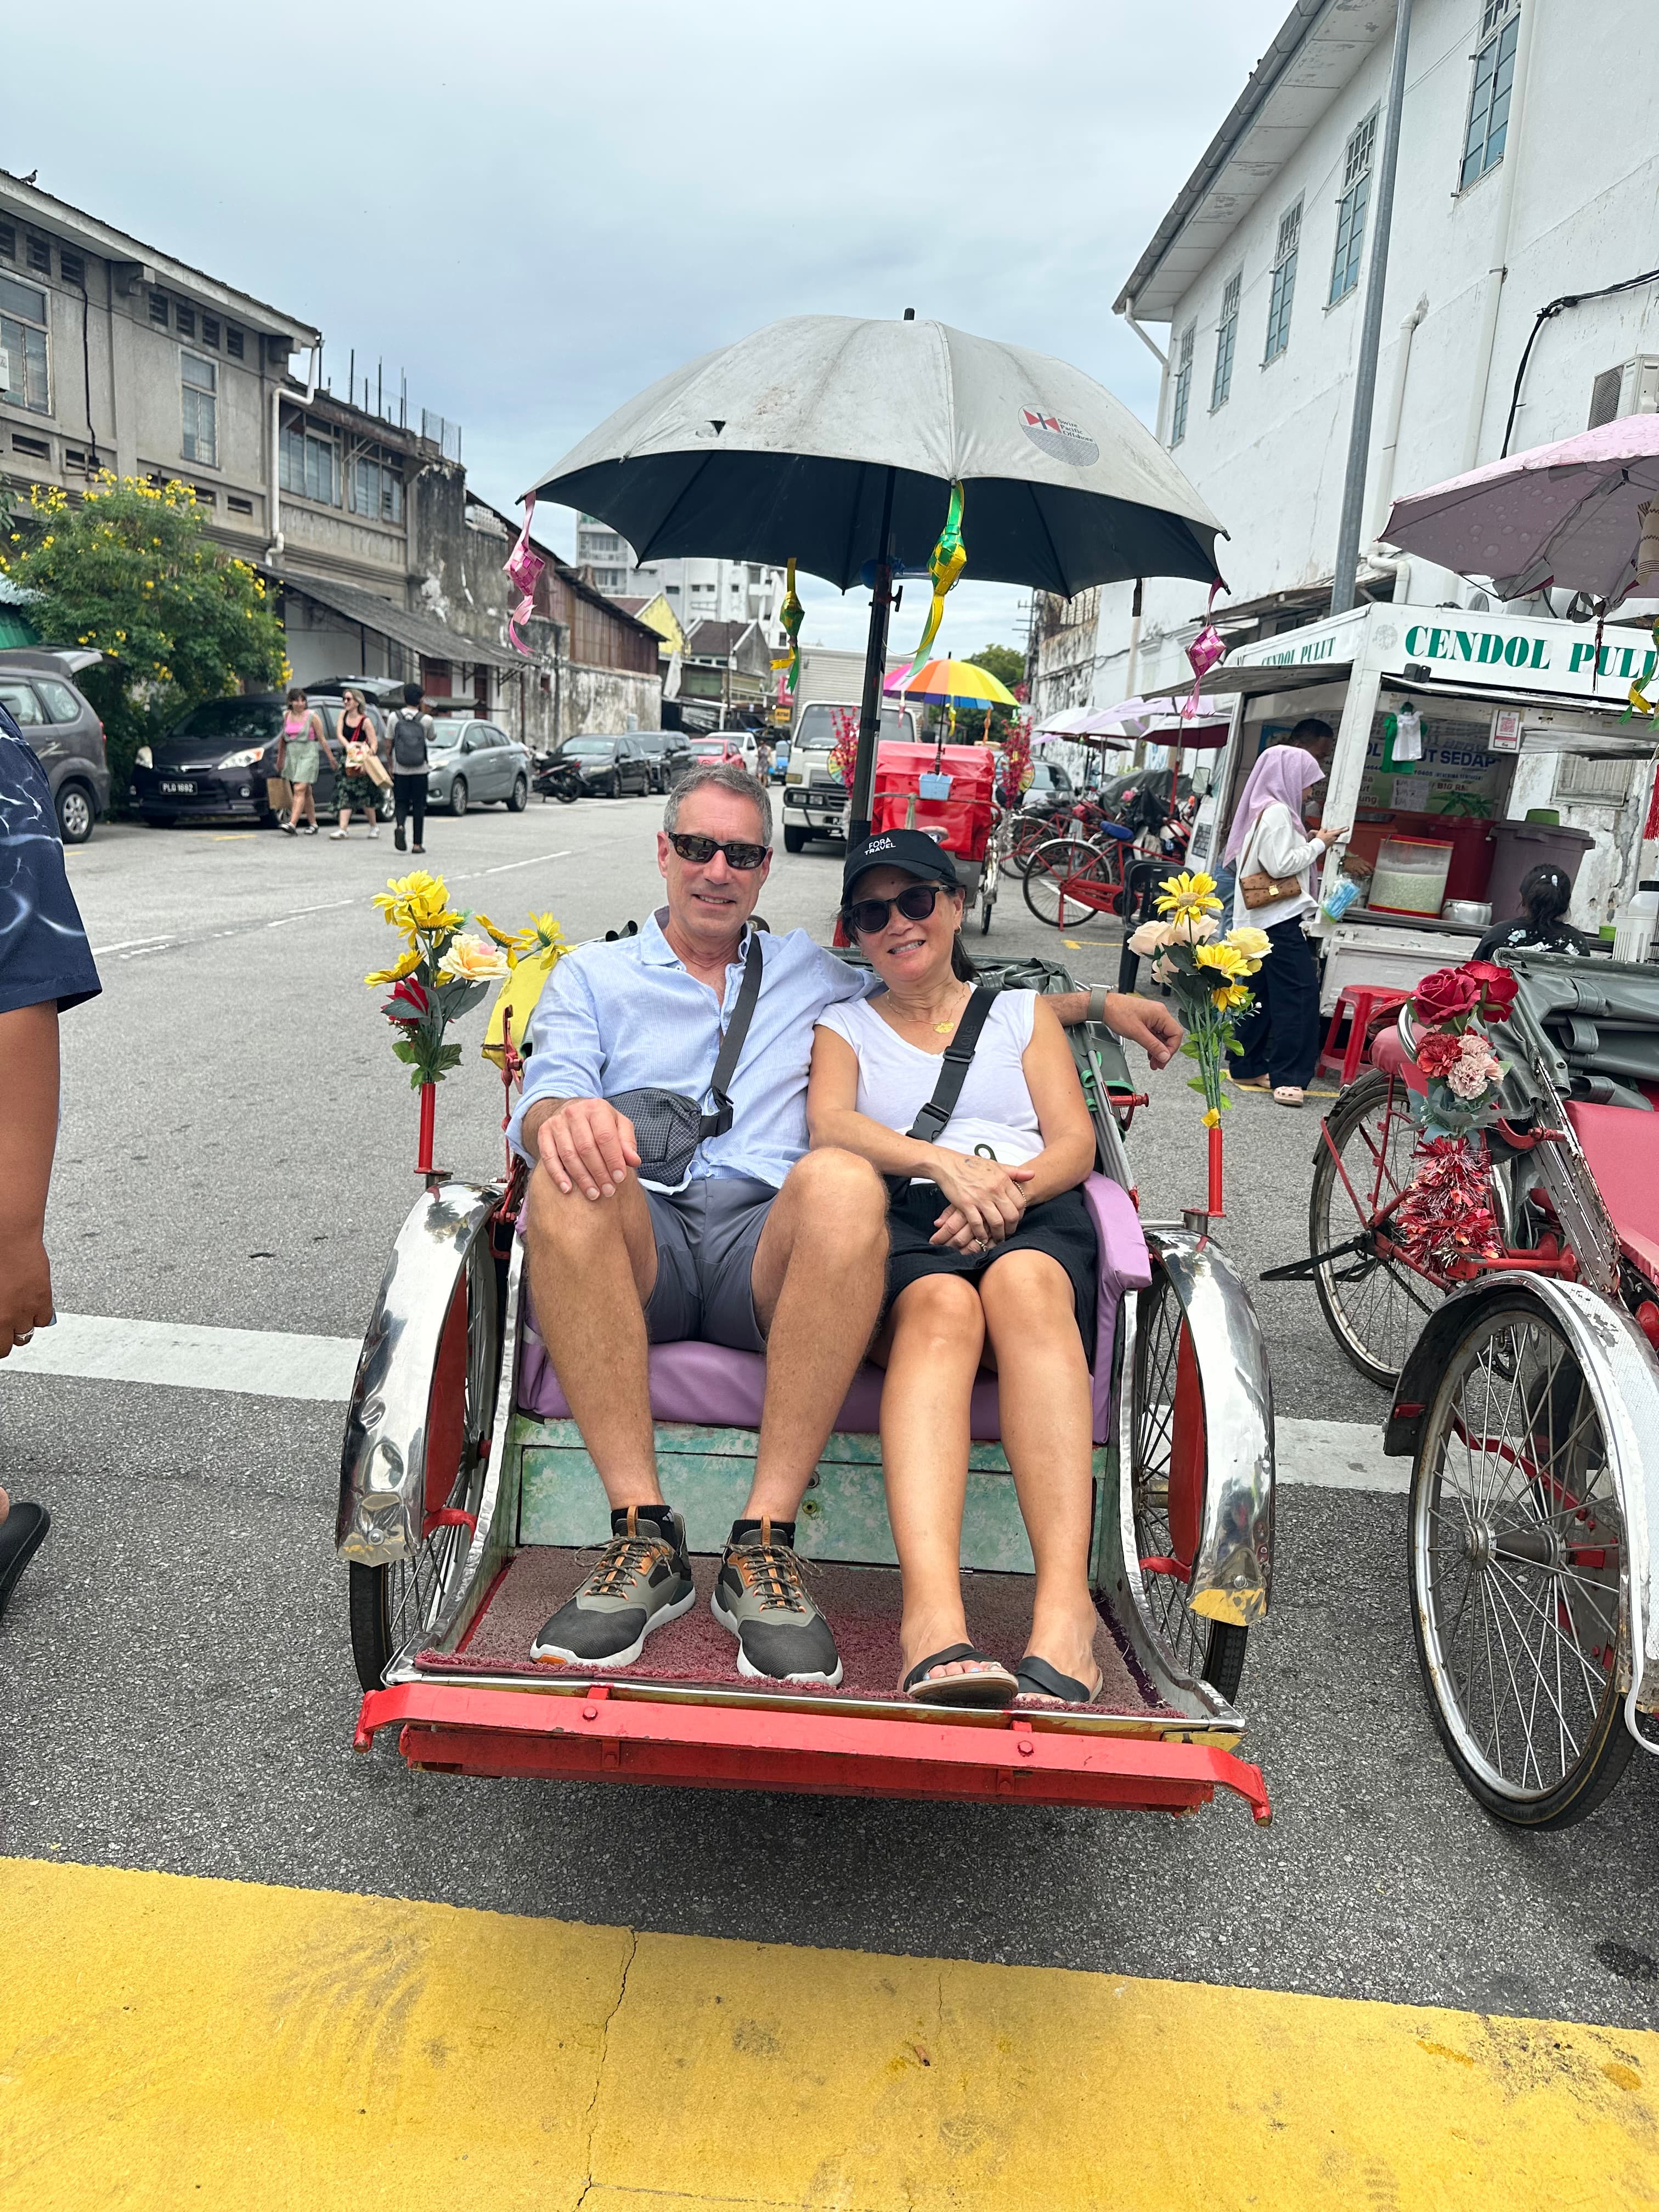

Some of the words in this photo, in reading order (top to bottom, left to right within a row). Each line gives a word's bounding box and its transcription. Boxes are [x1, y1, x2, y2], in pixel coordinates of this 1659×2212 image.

[1060, 424, 1083, 435] Pacific
[1063, 431, 1093, 442] Offshore
[1300, 636, 1336, 664] PULUT
[1405, 625, 1551, 670] CENDOL
[1440, 750, 1497, 768] SEDAP
[864, 842, 897, 855] TRAVEL
[869, 837, 891, 849] FORA
